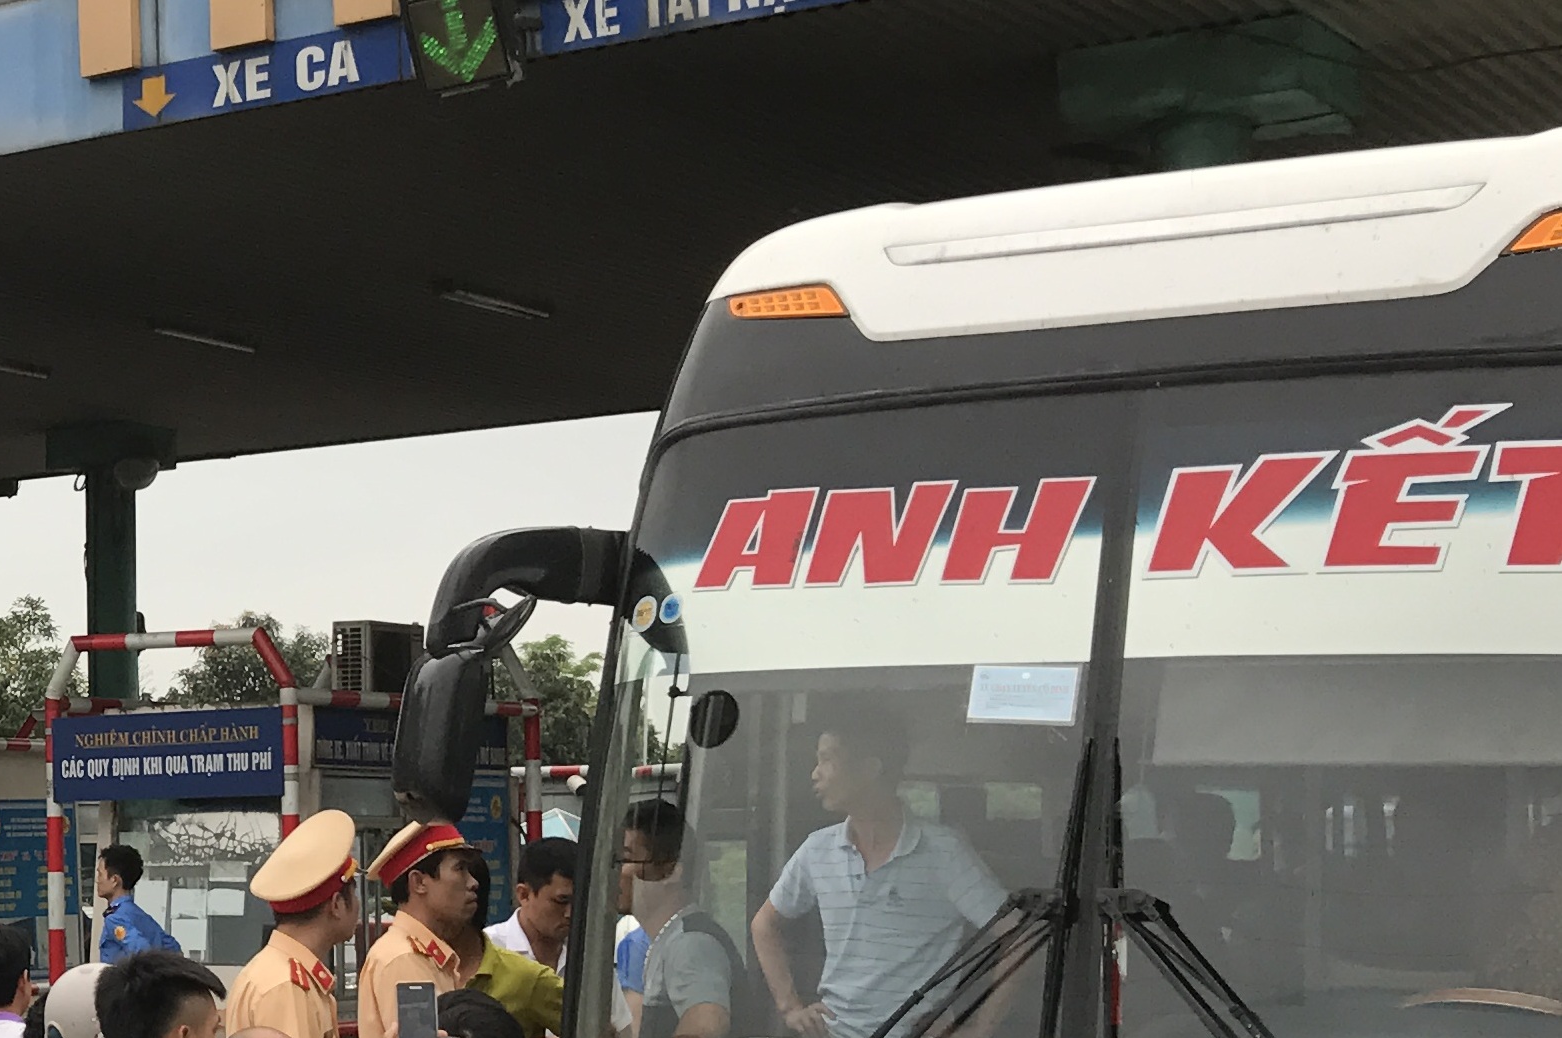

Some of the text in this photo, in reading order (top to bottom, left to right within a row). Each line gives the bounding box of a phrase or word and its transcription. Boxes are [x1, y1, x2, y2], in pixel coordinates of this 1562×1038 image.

[212, 53, 271, 107] XE
[692, 477, 1097, 592] ANH
[75, 728, 130, 748] NGHIÊM
[220, 722, 260, 742] HÀNH
[61, 747, 272, 780] CÁC QUY ĐỊNH KHI QUA TRẠM THU PHÍ
